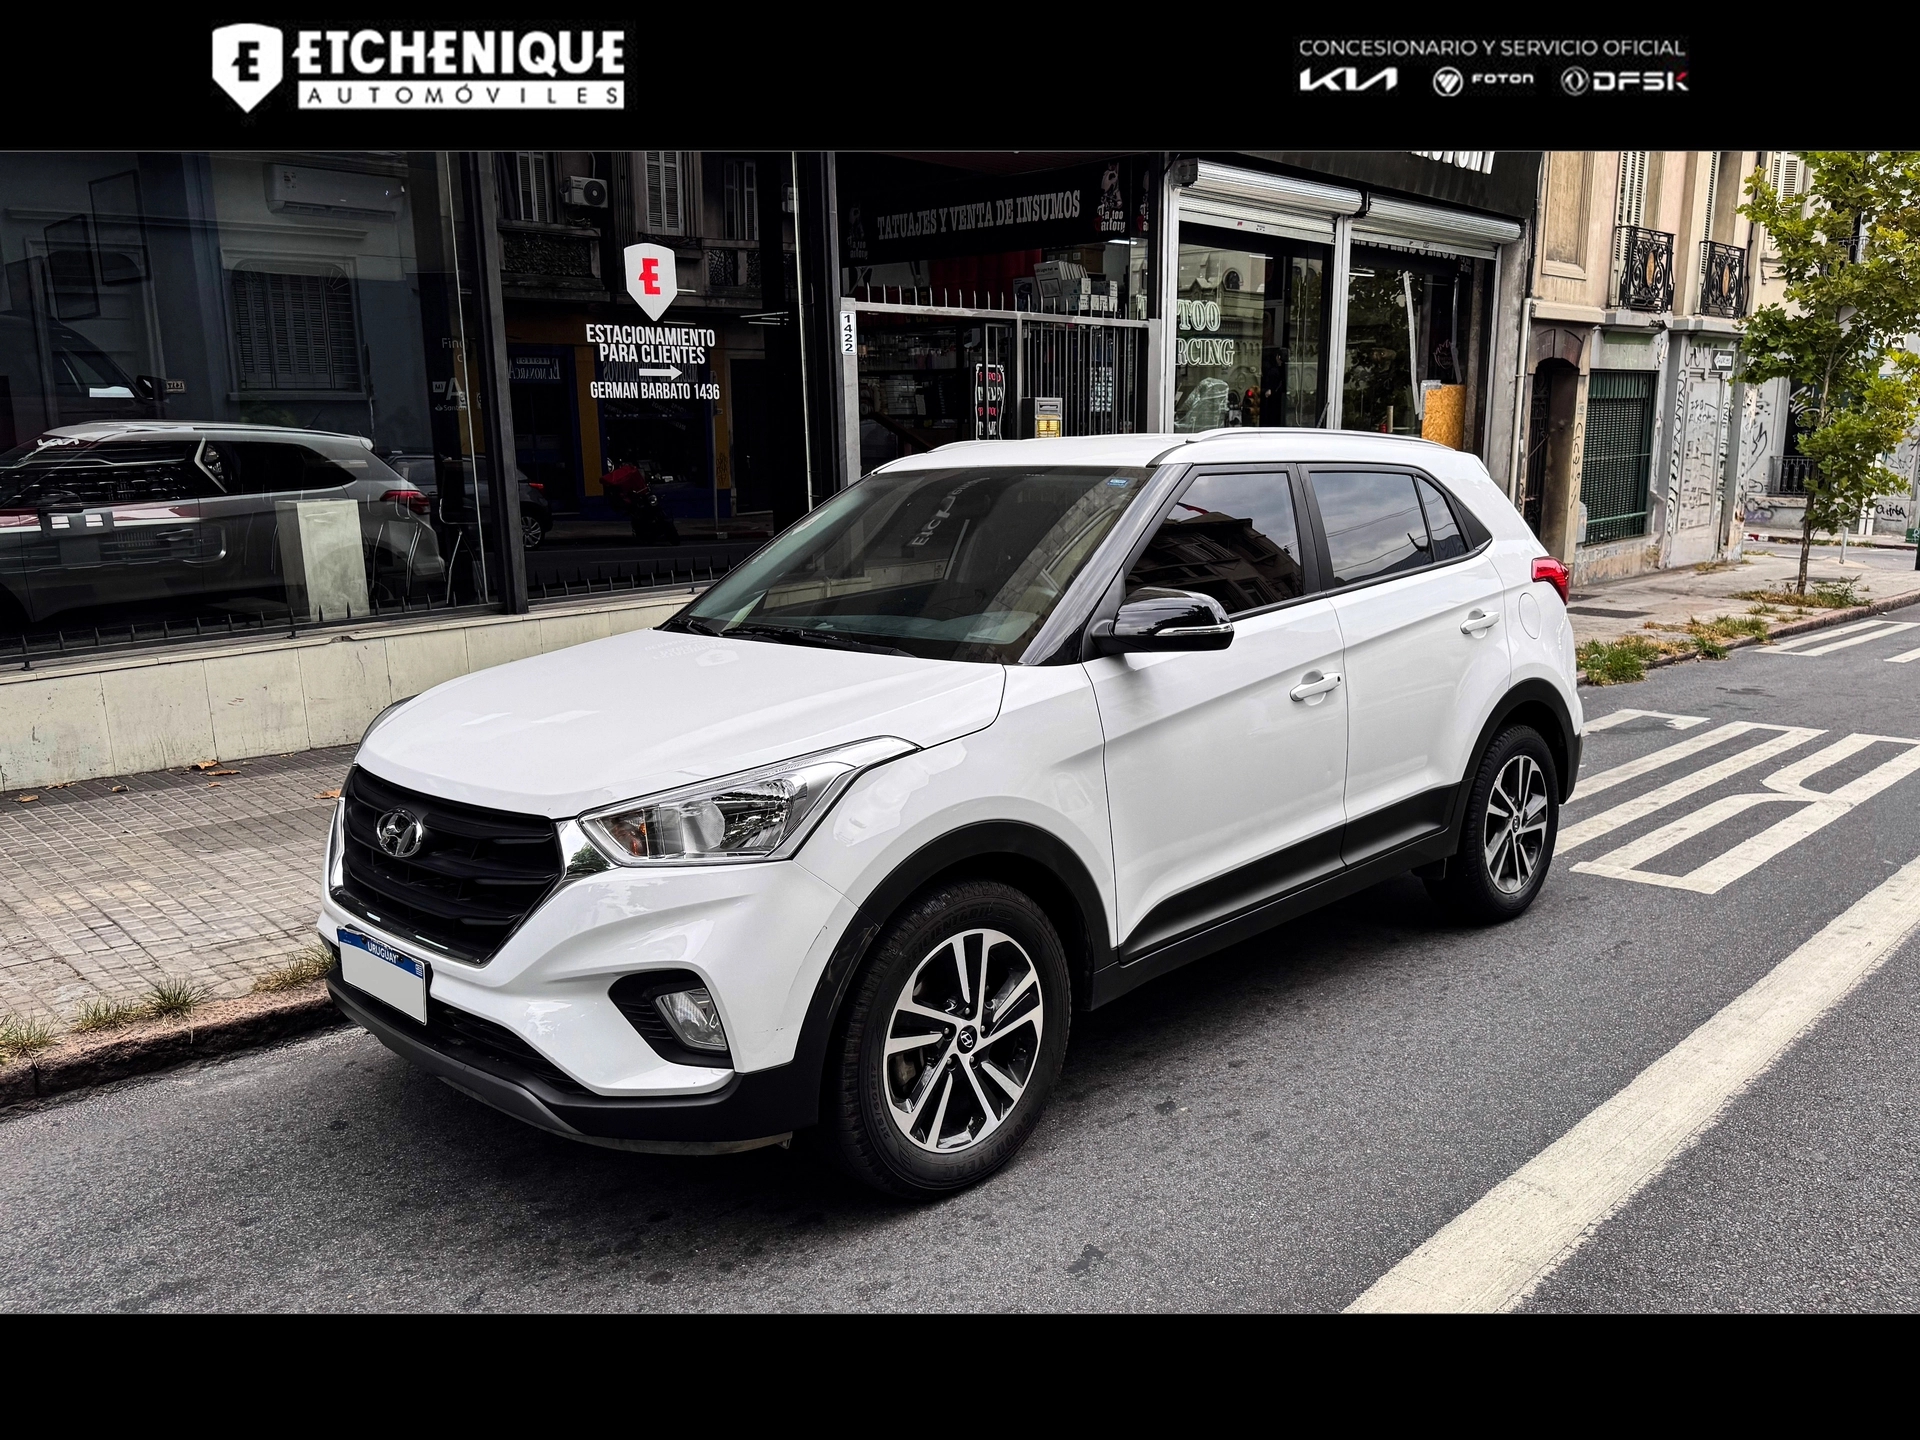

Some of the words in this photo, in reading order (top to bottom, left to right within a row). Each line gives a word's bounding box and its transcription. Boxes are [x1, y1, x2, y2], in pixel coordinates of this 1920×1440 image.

[877, 209, 937, 240] TATUAJES
[938, 207, 948, 233] Y
[949, 201, 994, 231] VENTA
[996, 198, 1014, 226] DE
[1016, 189, 1081, 223] INSUMOS
[585, 323, 716, 347] ESTACIONAMIENTO
[844, 314, 853, 352] 1422
[599, 343, 638, 362] PARA
[641, 345, 706, 364] CLIENTES
[590, 381, 639, 399] GERMAN
[640, 382, 691, 399] BARBATO
[694, 383, 720, 400] 1436
[367, 941, 399, 964] URUGUAY
